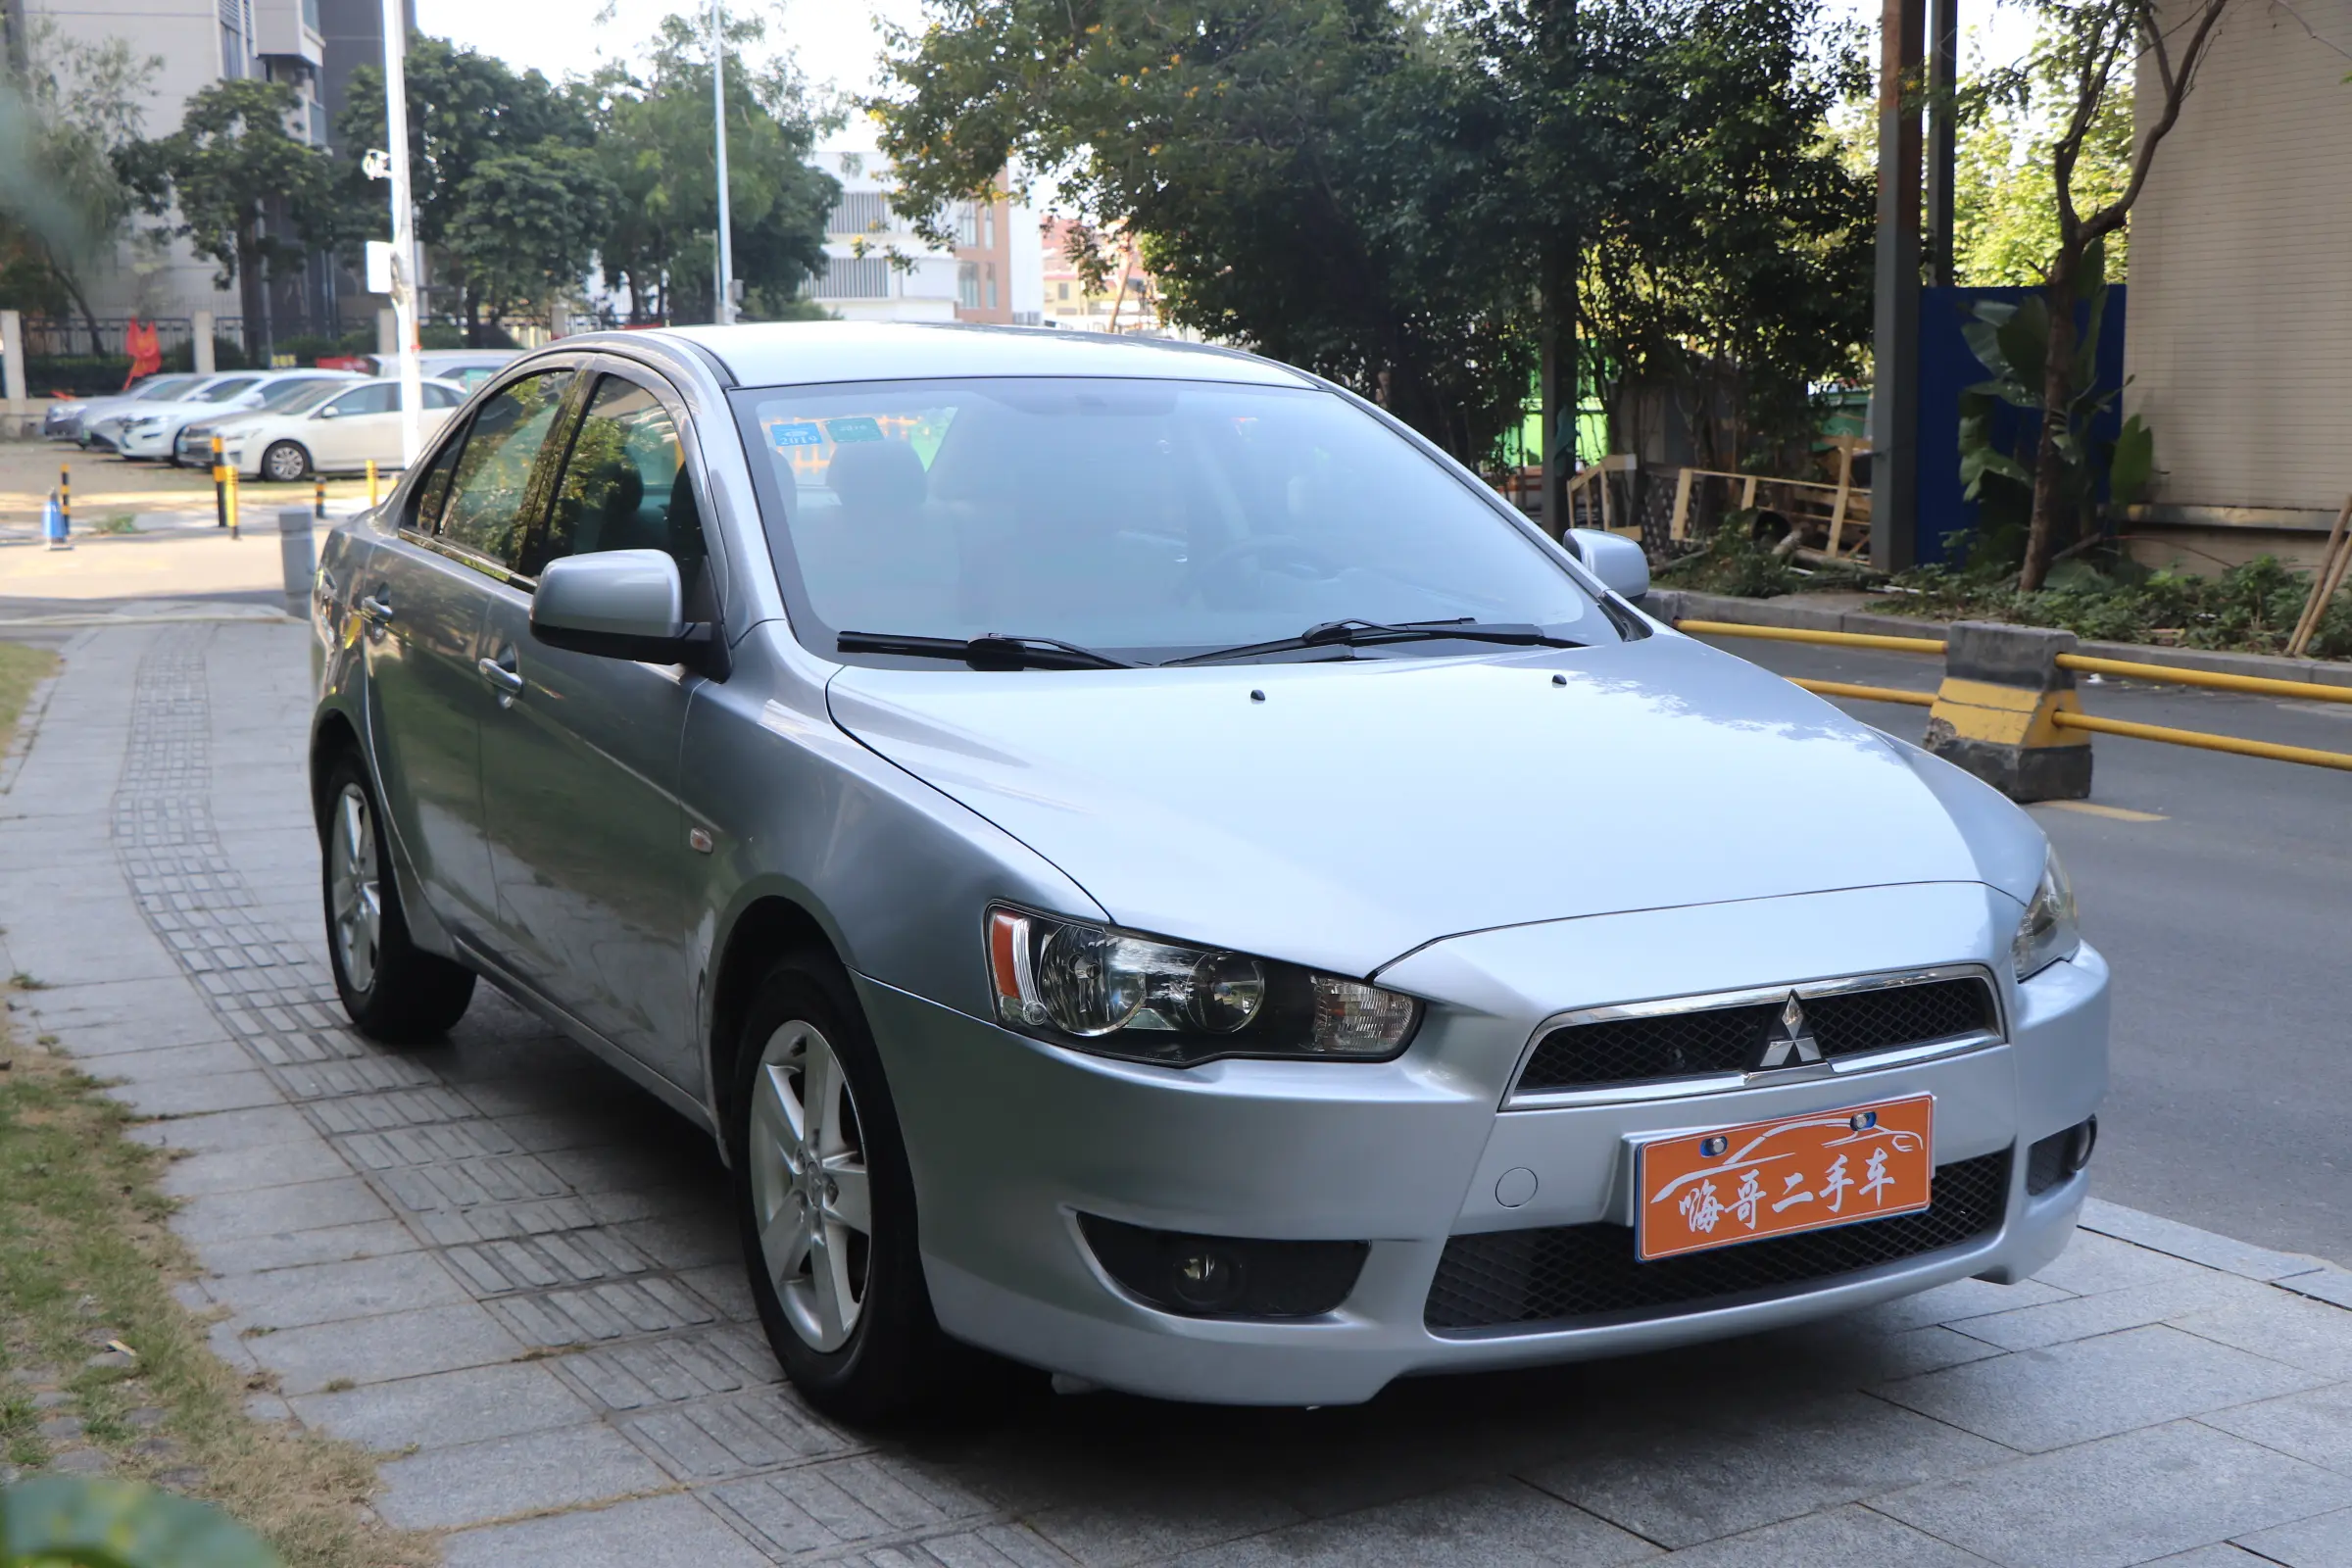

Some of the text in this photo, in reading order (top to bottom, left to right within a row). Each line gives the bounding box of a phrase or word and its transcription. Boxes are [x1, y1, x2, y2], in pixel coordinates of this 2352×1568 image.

[1679, 1147, 1895, 1233] 嗨哥二手车
